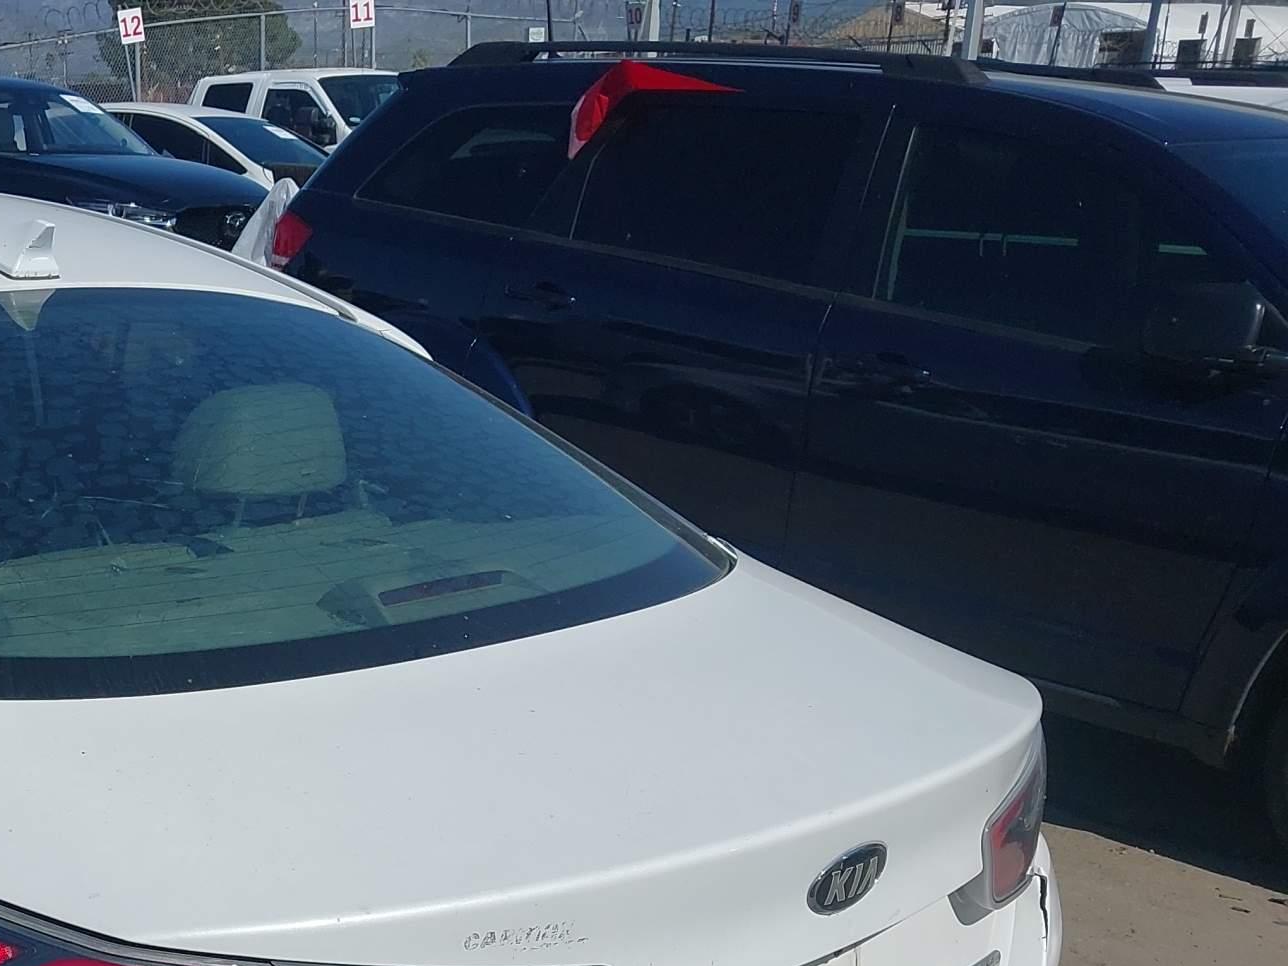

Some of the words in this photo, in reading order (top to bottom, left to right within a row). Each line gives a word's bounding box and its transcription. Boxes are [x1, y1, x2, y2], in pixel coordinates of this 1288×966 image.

[352, 1, 373, 22] 11
[627, 7, 642, 25] 10
[120, 15, 143, 38] 12
[823, 855, 879, 906] KIA
